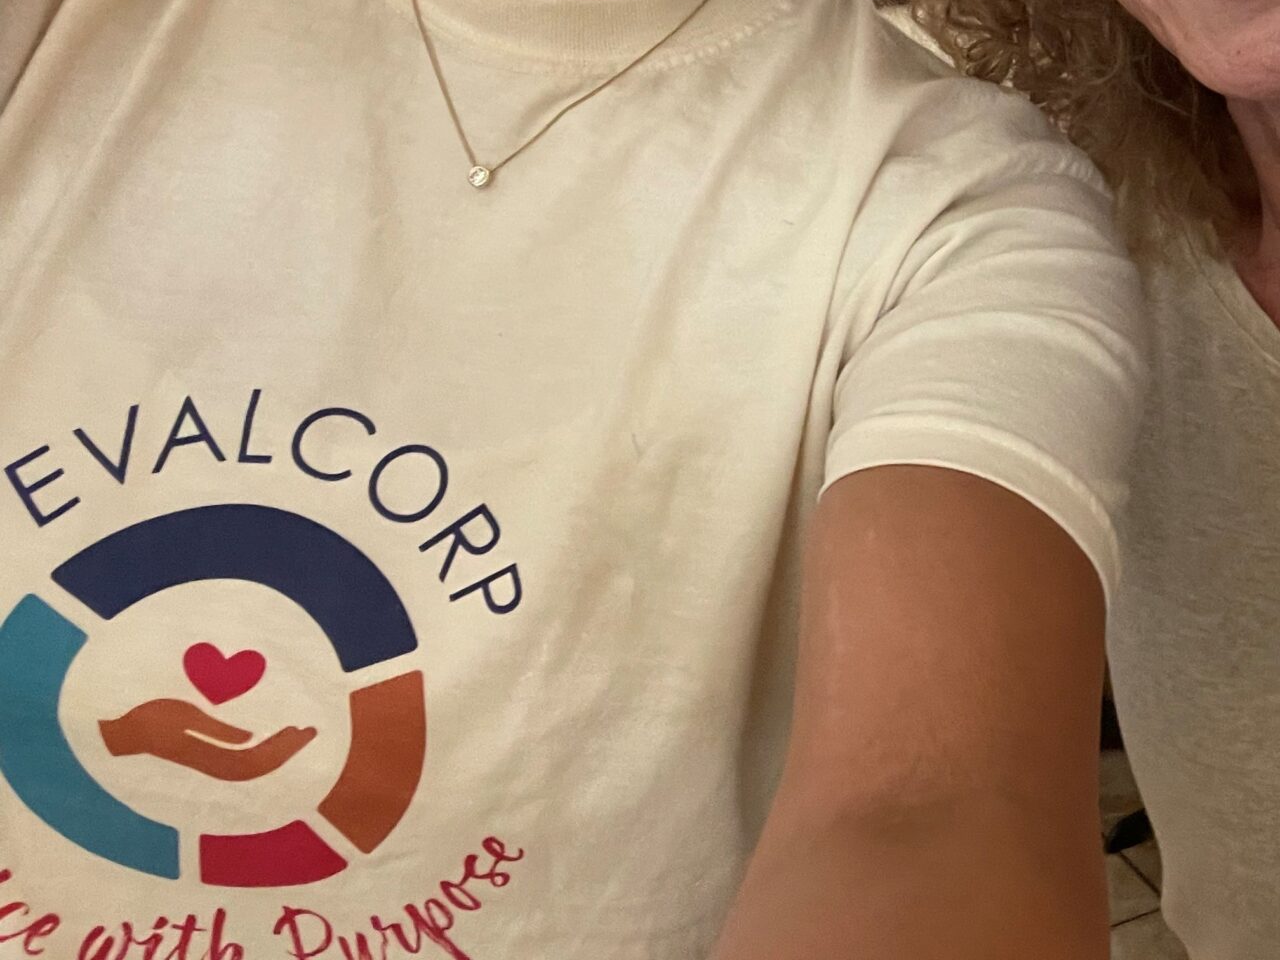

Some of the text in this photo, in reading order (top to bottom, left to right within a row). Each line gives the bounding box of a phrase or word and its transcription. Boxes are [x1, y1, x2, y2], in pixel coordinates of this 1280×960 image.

[3, 388, 524, 616] EVALCORP
[77, 907, 245, 960] with
[272, 835, 525, 960] Purpose
